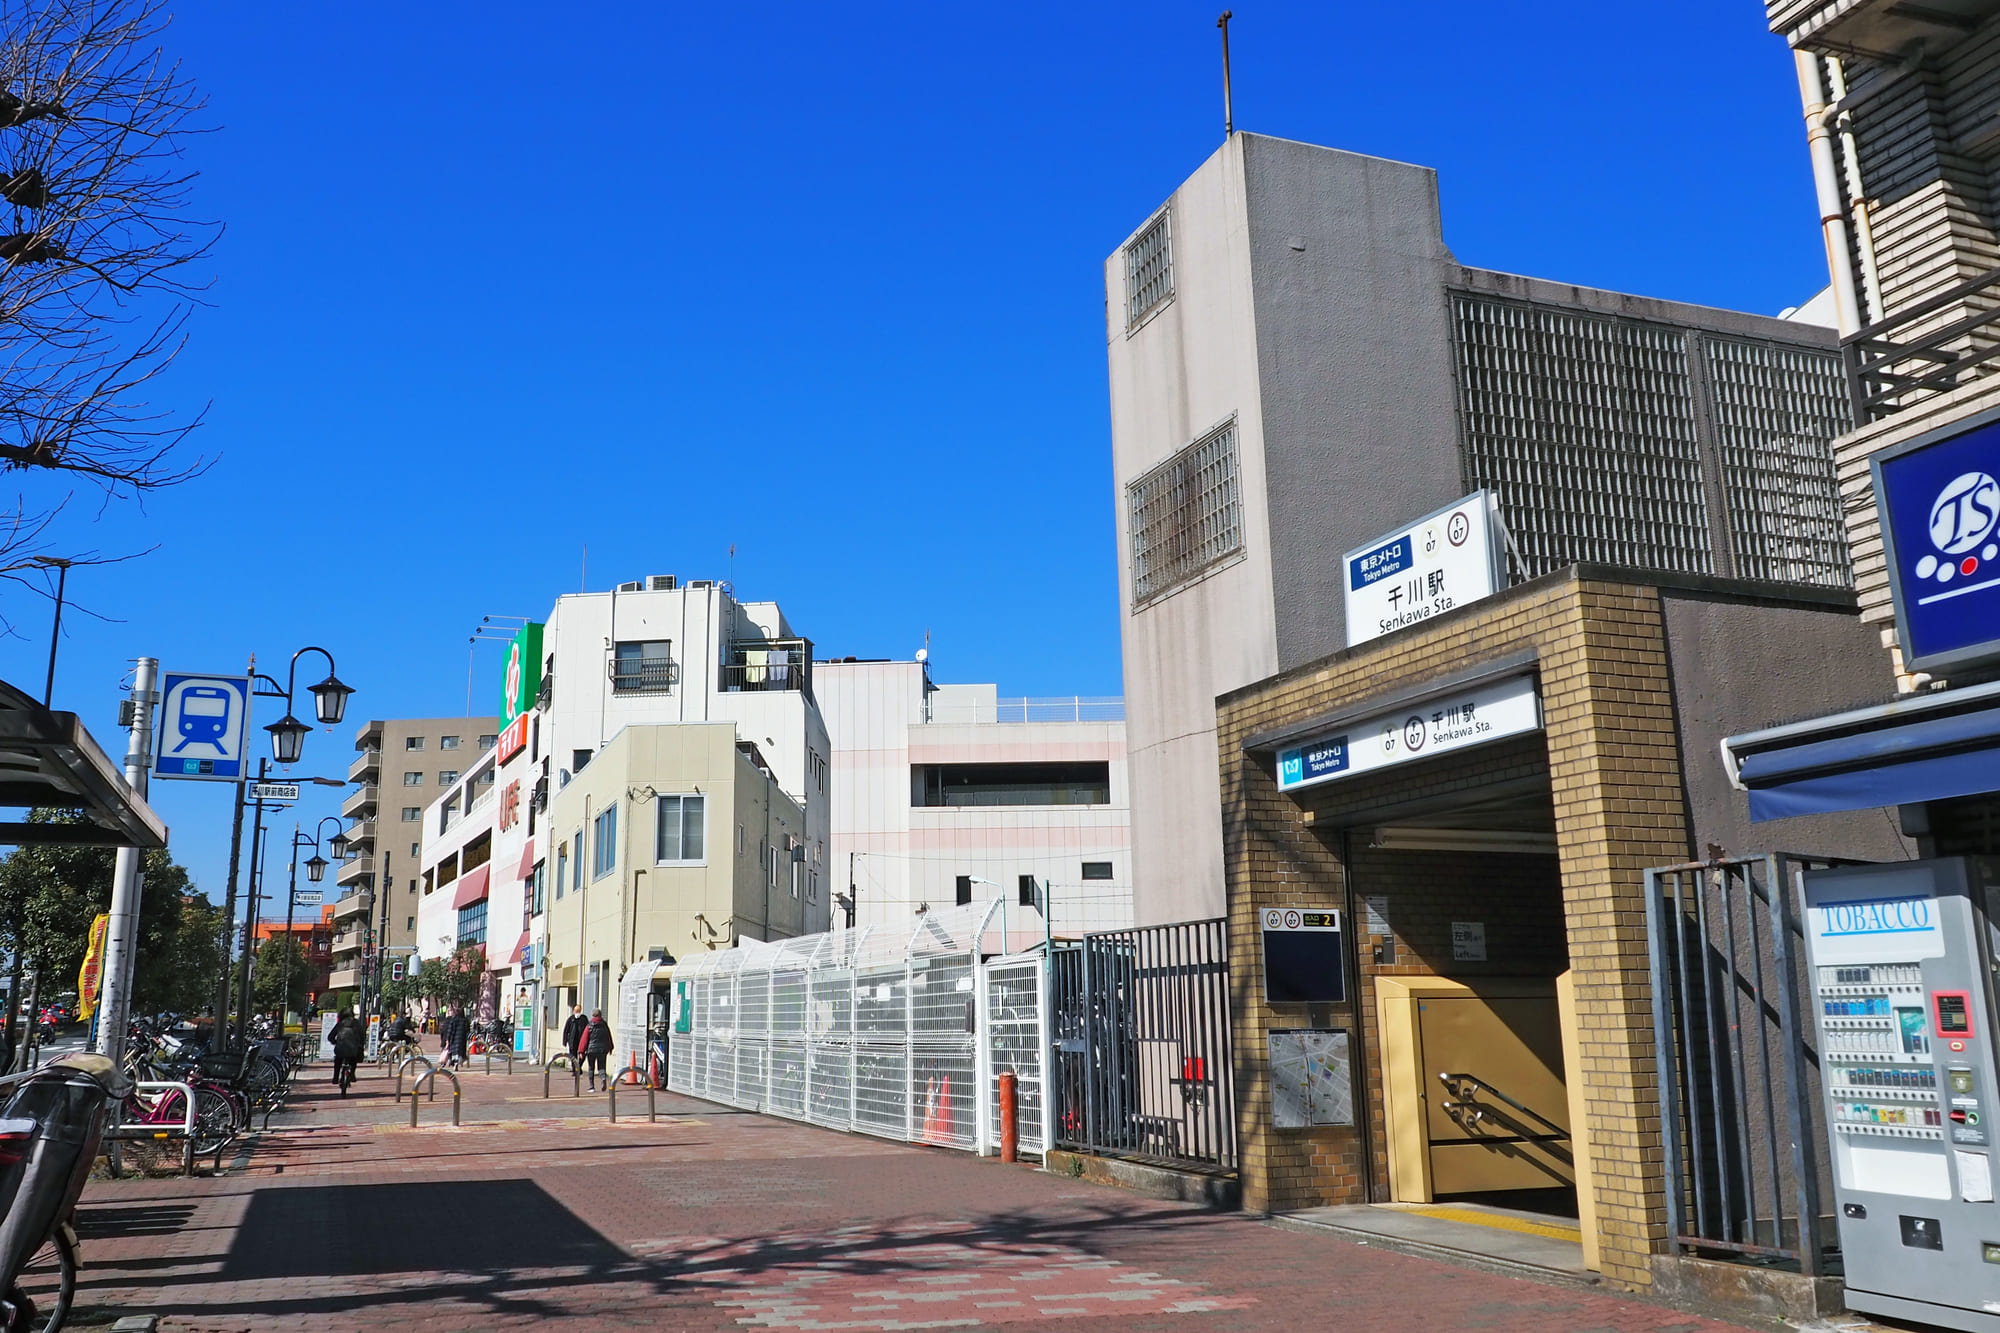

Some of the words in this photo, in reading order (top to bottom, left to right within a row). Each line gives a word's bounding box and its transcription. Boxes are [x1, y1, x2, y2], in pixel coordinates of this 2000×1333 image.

[1455, 518, 1460, 527] F
[1427, 530, 1433, 539] Y
[1453, 527, 1464, 540] 07
[1426, 540, 1436, 552] 07
[1360, 544, 1402, 572] 東京メトロ
[1363, 569, 1381, 583] Tokyo
[1381, 561, 1400, 576] Metro
[1388, 569, 1445, 611] 千川駅
[1379, 606, 1430, 634] Senkawa
[1434, 597, 1456, 614] Sta.
[1431, 703, 1476, 730] 千川駅
[501, 722, 519, 758] ライフ
[1386, 728, 1392, 738] Y
[1409, 733, 1420, 745] 07
[1433, 726, 1473, 744] Senkawa
[1476, 721, 1493, 734] Sta.
[1385, 739, 1395, 751] 07
[1309, 746, 1341, 763] 東京メトロ
[1311, 762, 1325, 772] Tokyo
[1325, 758, 1340, 769] Metro
[500, 778, 520, 831] LIFE
[1323, 914, 1331, 926] 2
[1821, 899, 1929, 933] TOBACCO
